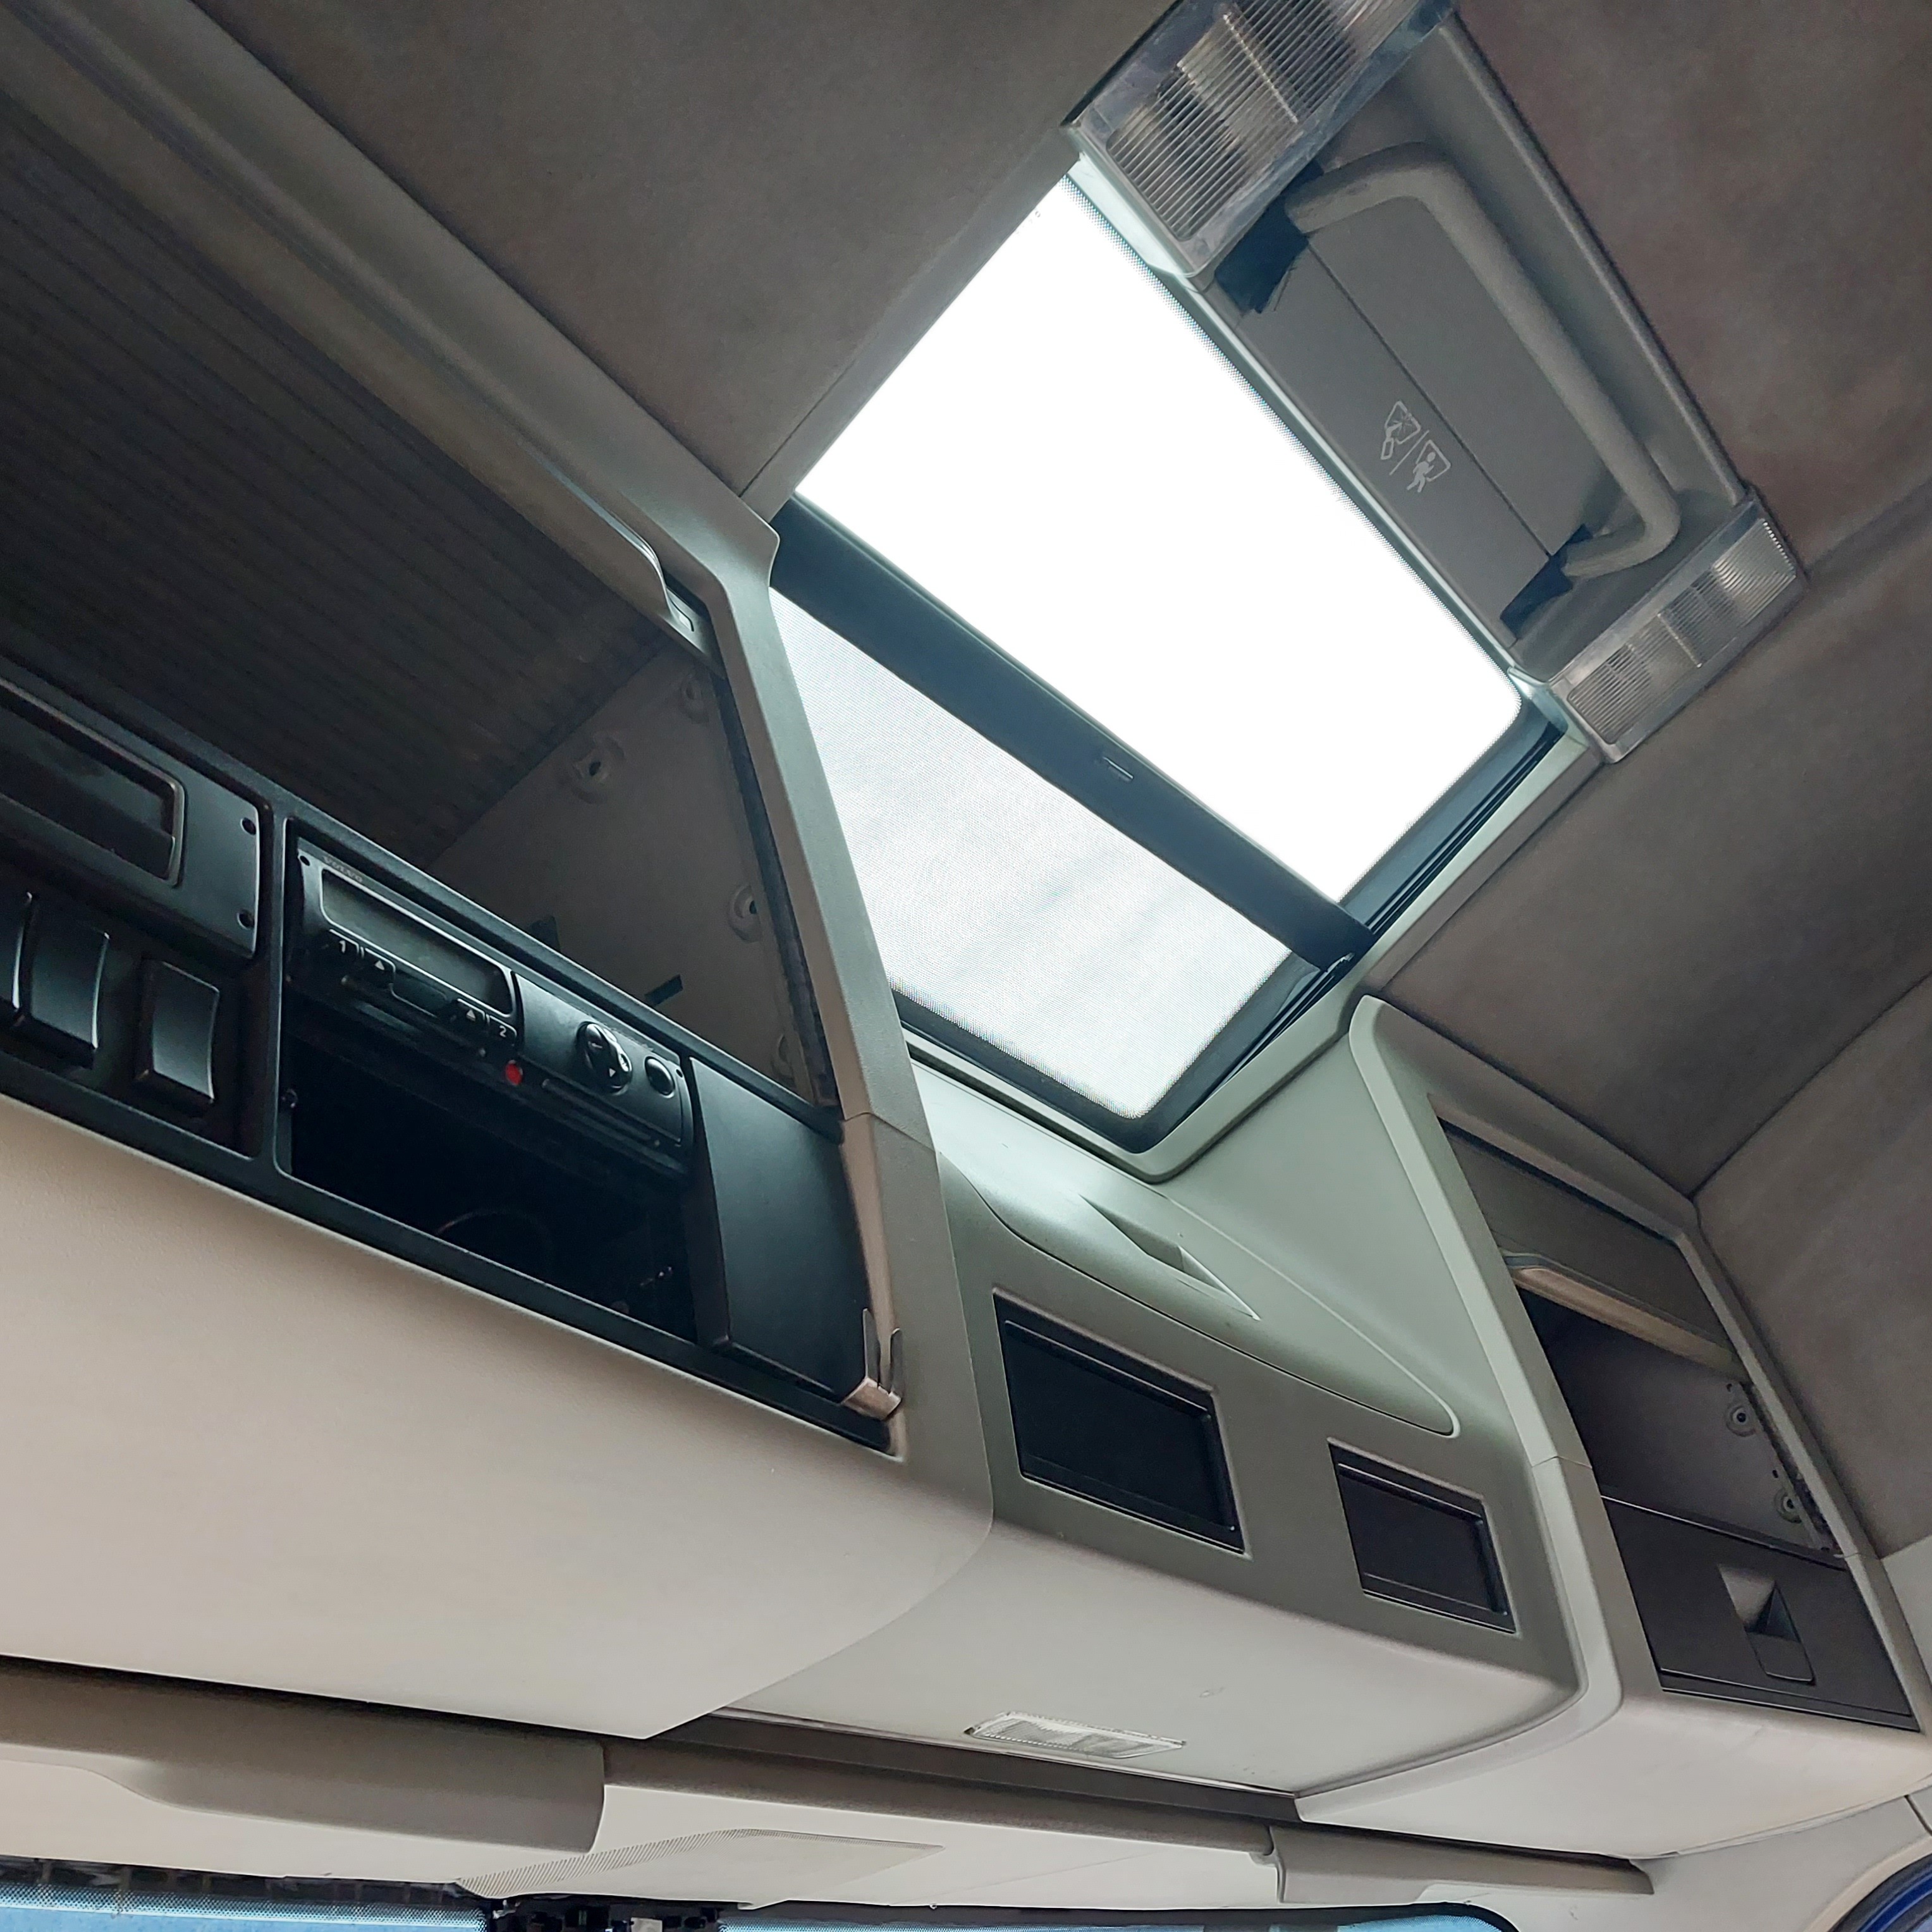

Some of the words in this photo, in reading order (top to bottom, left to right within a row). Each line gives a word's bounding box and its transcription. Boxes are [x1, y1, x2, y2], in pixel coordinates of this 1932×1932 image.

[322, 855, 363, 883] VOLVO
[339, 940, 346, 953] 1
[499, 1025, 506, 1037] 2
